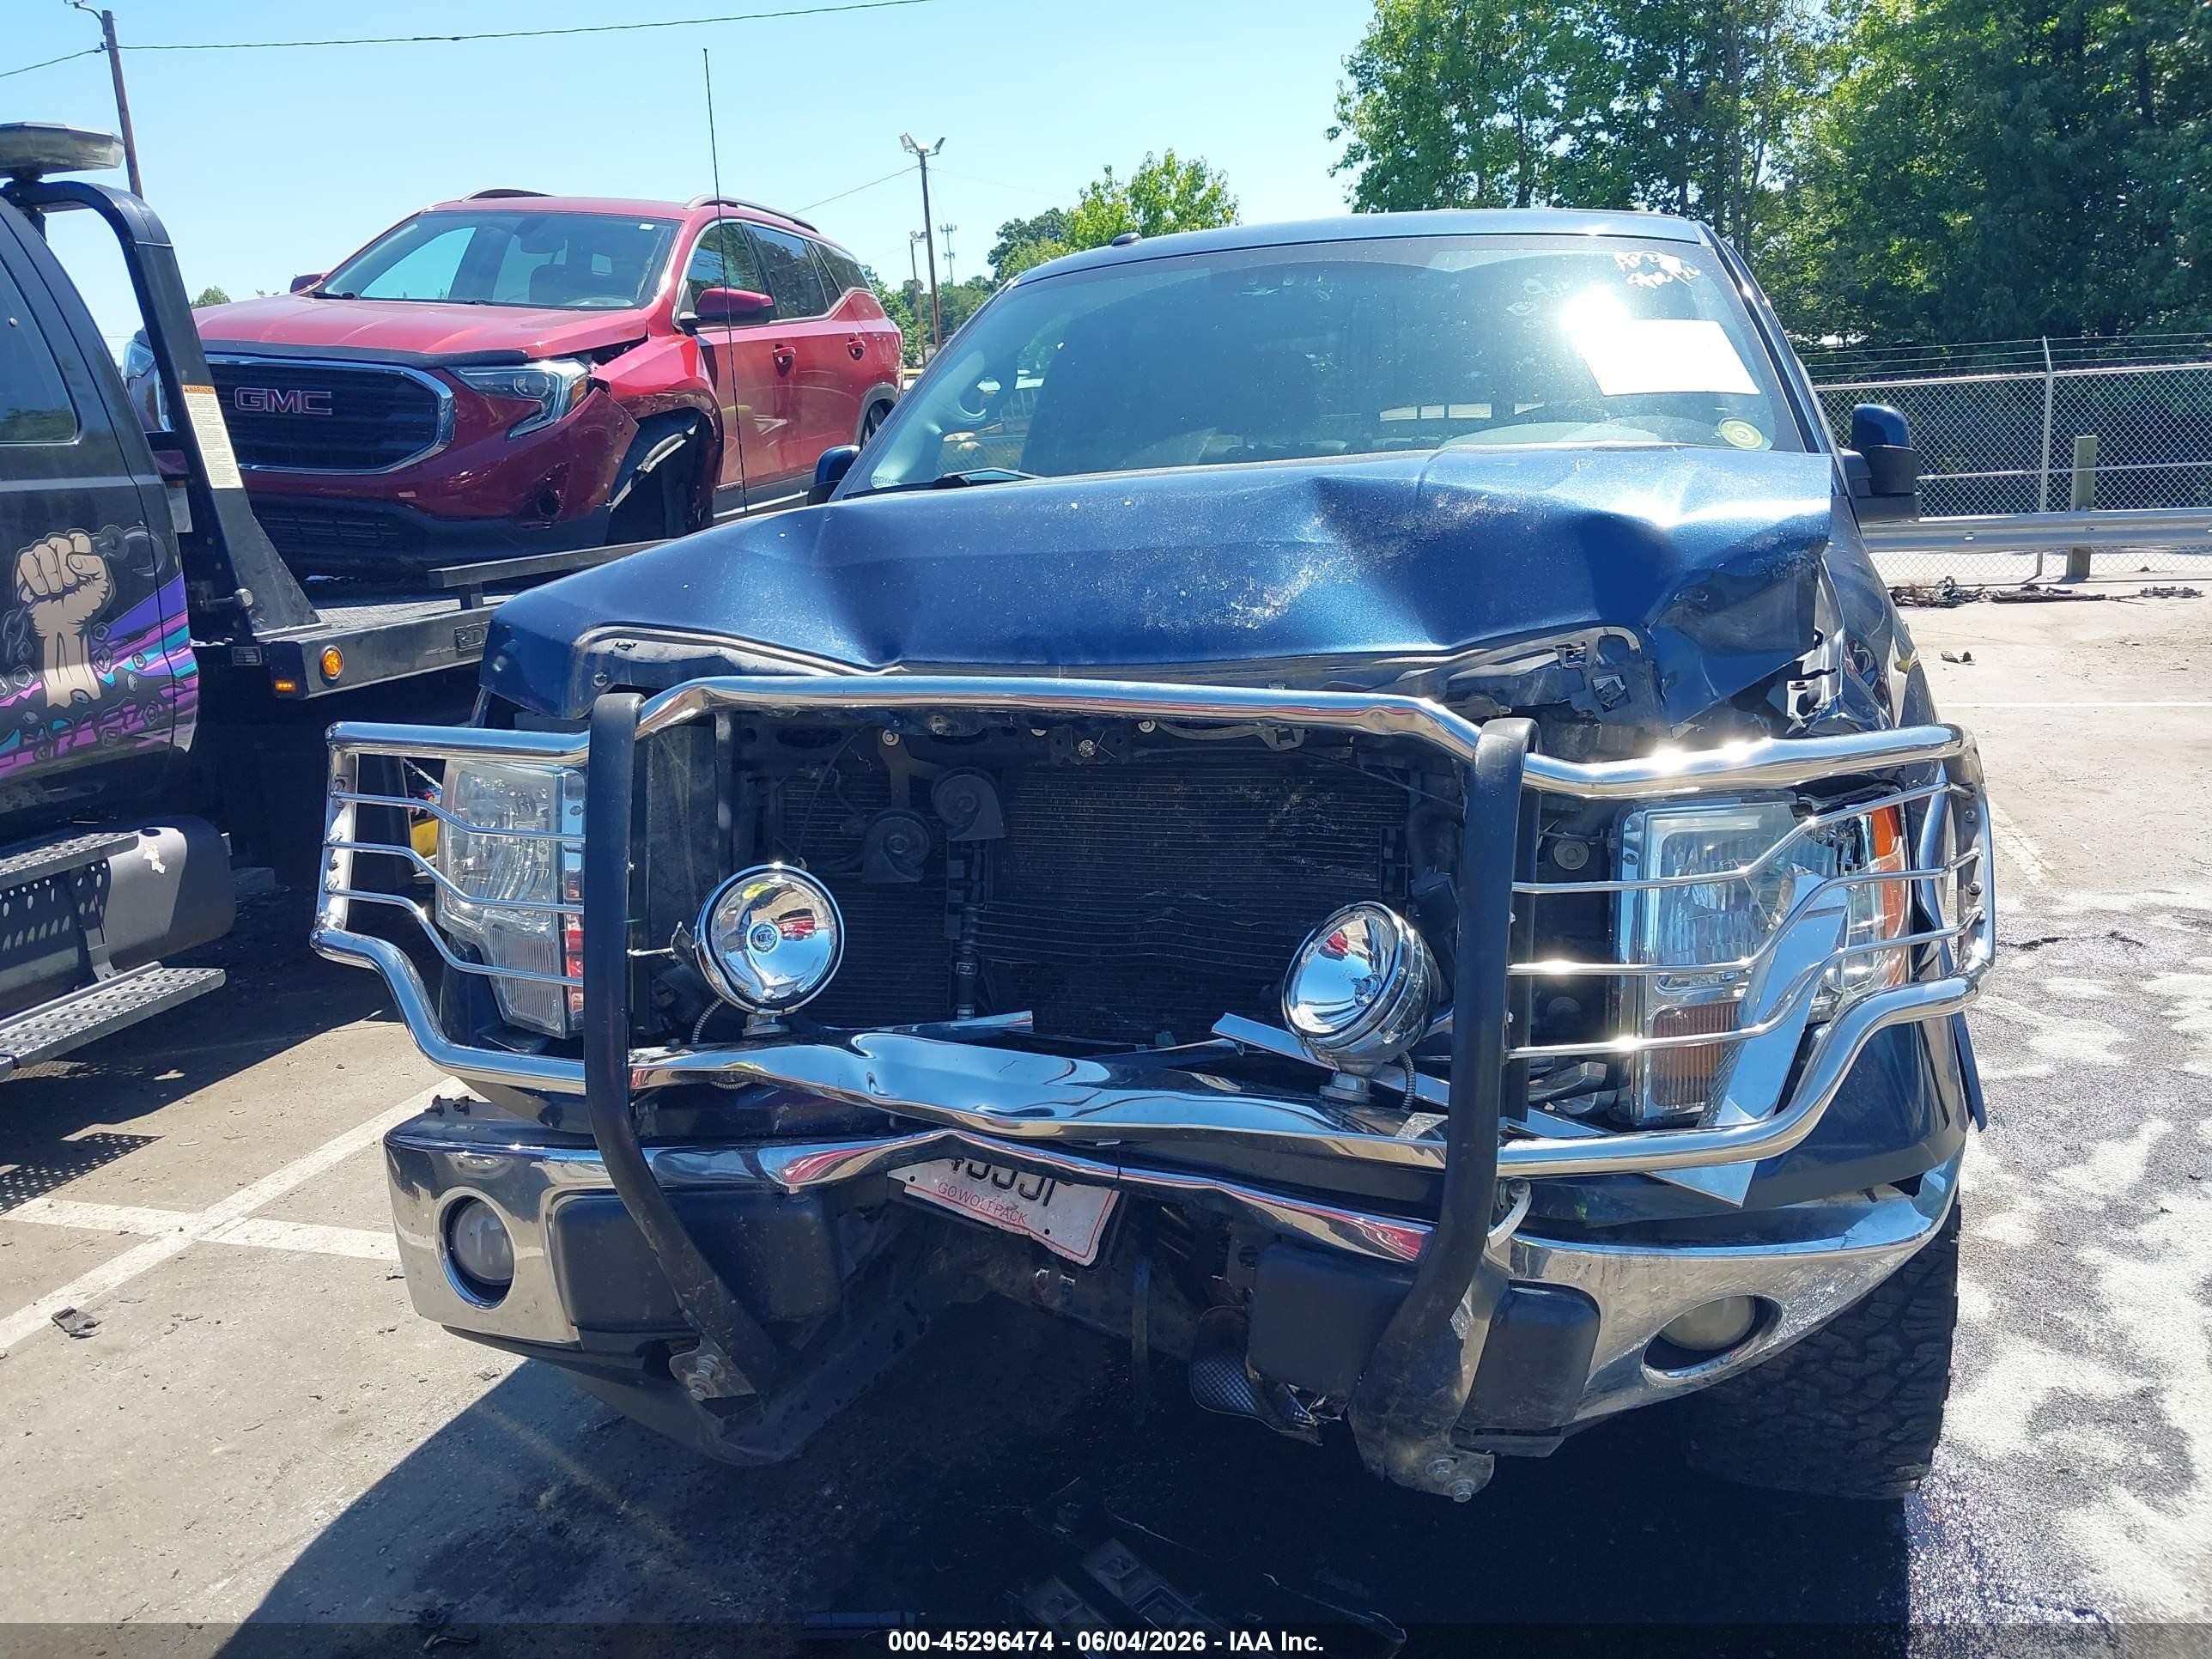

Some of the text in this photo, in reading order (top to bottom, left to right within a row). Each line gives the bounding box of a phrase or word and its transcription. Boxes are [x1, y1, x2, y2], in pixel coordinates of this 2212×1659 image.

[234, 387, 332, 416] GMC
[938, 1182, 957, 1197] GO
[958, 1189, 1029, 1224] WOLFPACK
